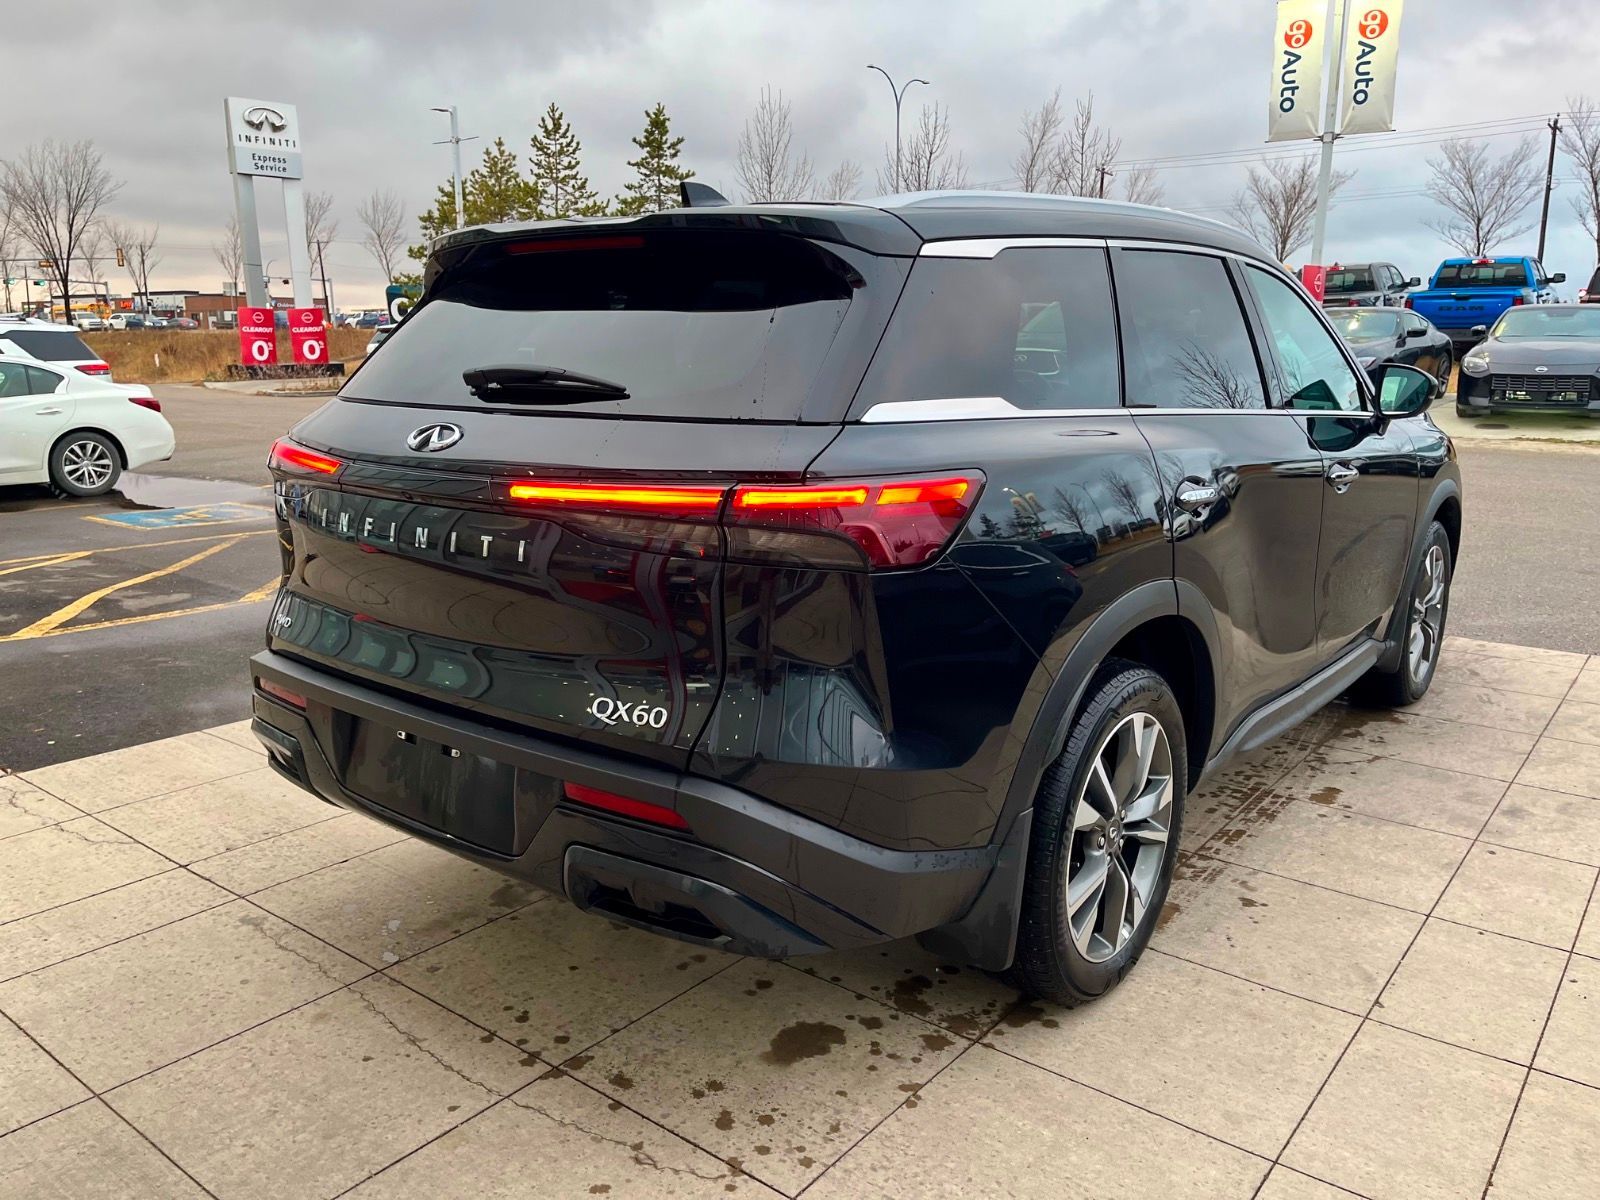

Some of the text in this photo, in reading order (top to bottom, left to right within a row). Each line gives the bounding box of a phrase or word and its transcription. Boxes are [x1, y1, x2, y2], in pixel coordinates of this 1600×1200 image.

[1280, 20, 1307, 113] go Auto
[1353, 9, 1382, 105] go Auto
[238, 134, 296, 148] INFINITI
[252, 153, 287, 164] Express
[254, 162, 287, 172] Service
[321, 508, 526, 562] INFINITI
[591, 697, 668, 729] QX60
